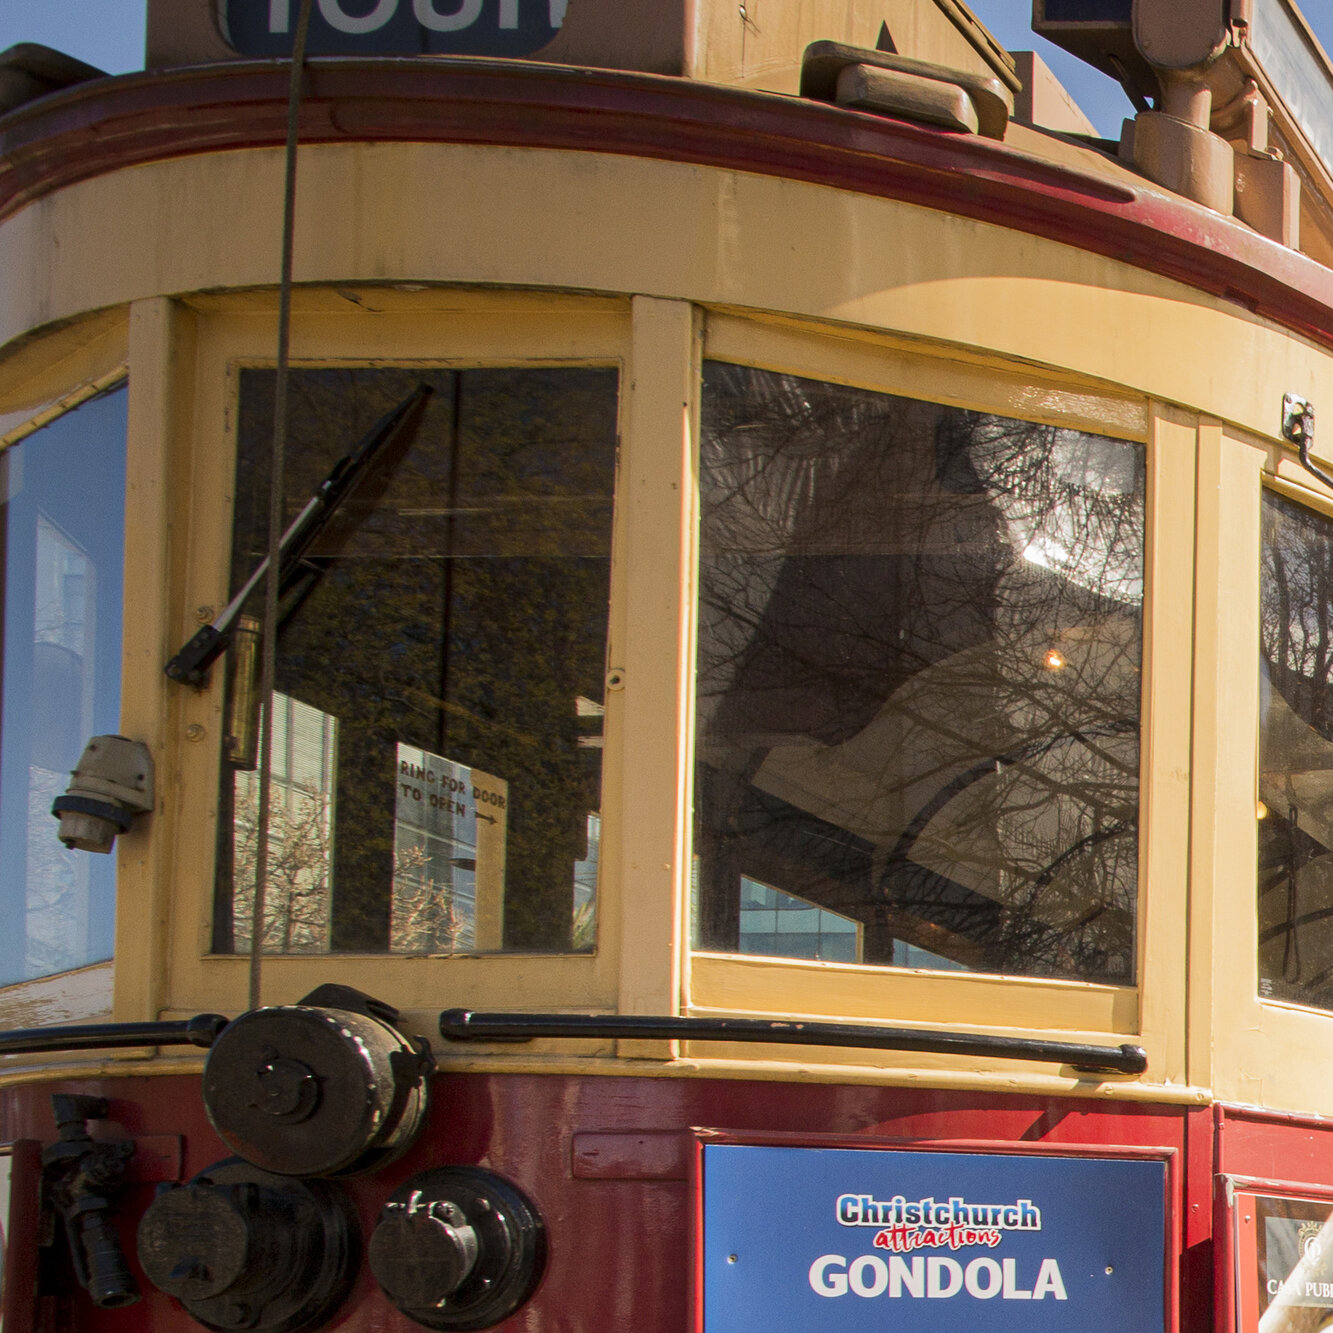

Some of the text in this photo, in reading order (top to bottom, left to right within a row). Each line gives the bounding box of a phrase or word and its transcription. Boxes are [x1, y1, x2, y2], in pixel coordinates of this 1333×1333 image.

[400, 760, 506, 810] RING FOR DOOR
[401, 783, 466, 818] TO OPEN
[838, 1195, 1040, 1230] Christchurch
[874, 1222, 1001, 1251] attractions
[808, 1254, 1068, 1300] GONDOLA
